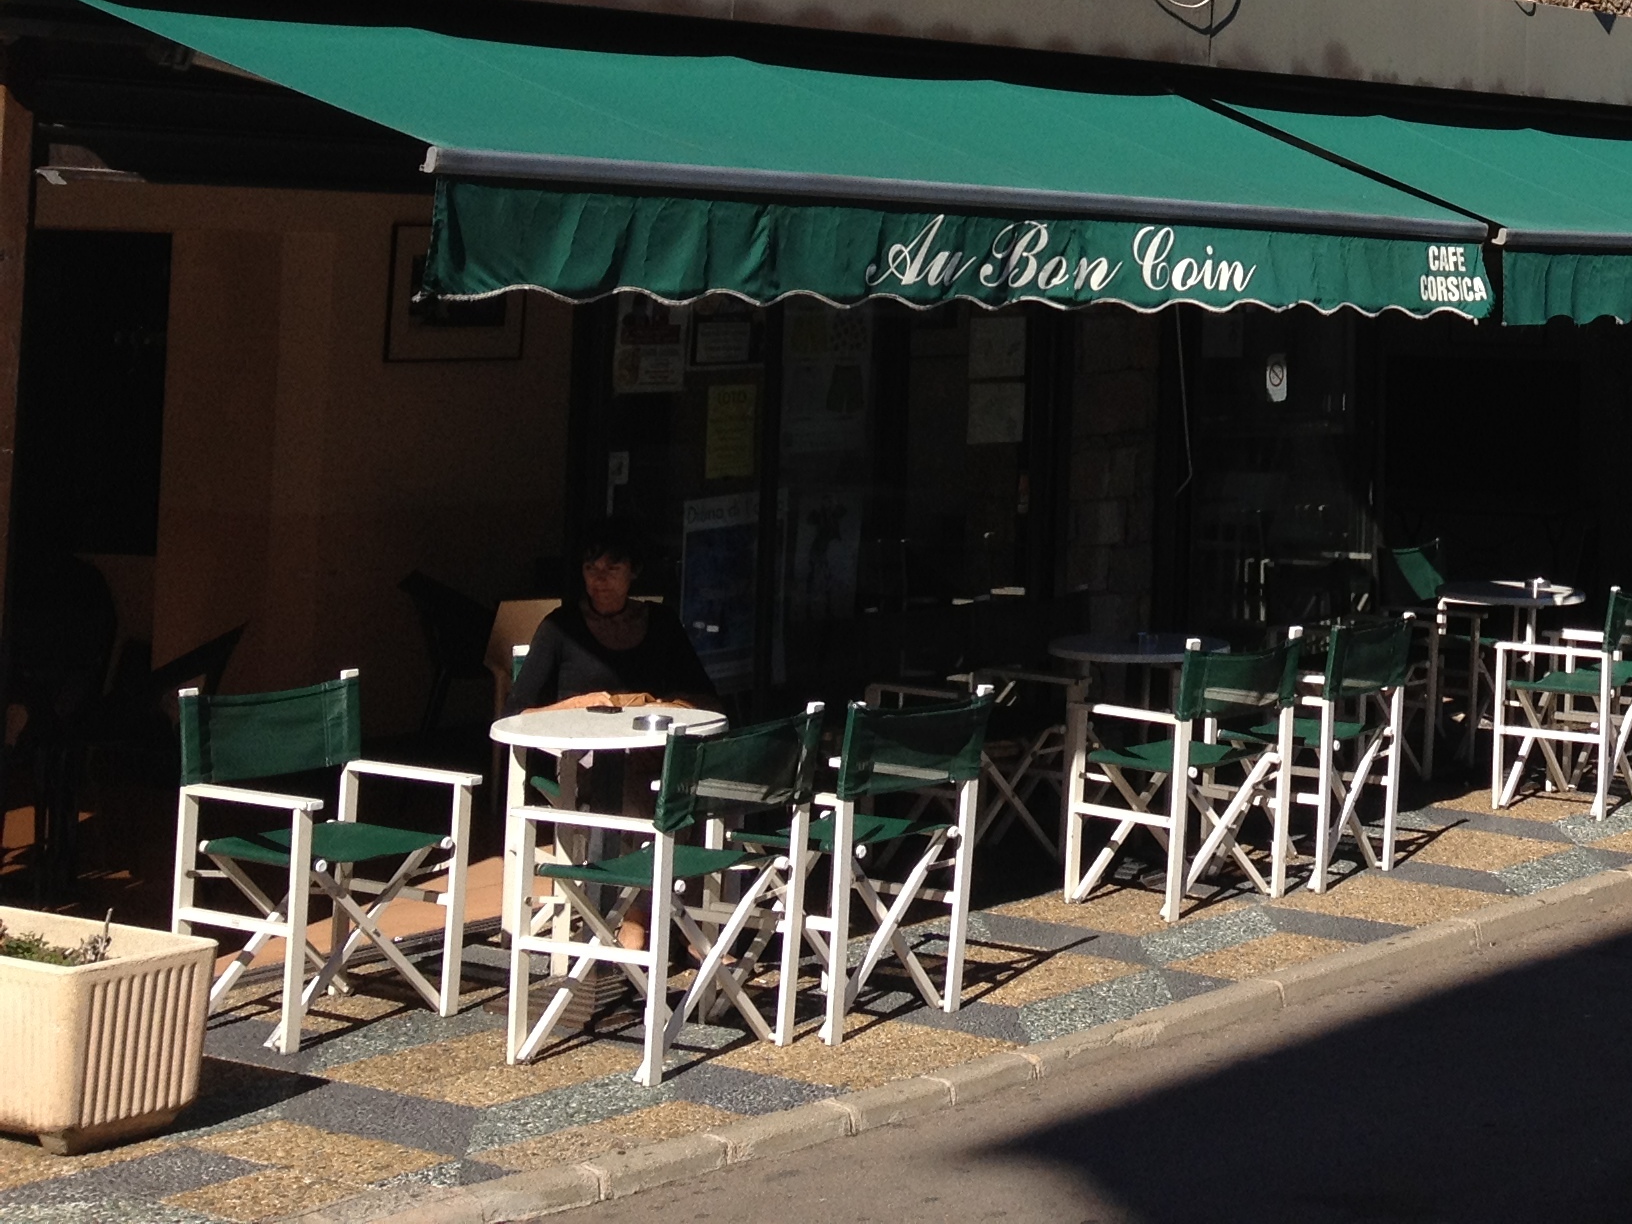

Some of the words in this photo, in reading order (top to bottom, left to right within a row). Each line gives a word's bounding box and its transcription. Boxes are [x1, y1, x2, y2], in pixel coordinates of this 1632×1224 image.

[866, 214, 976, 287] Au
[979, 219, 1123, 291] Bon
[1132, 225, 1257, 293] Coin
[1428, 245, 1466, 271] CAFE
[1420, 275, 1487, 302] CORSICA
